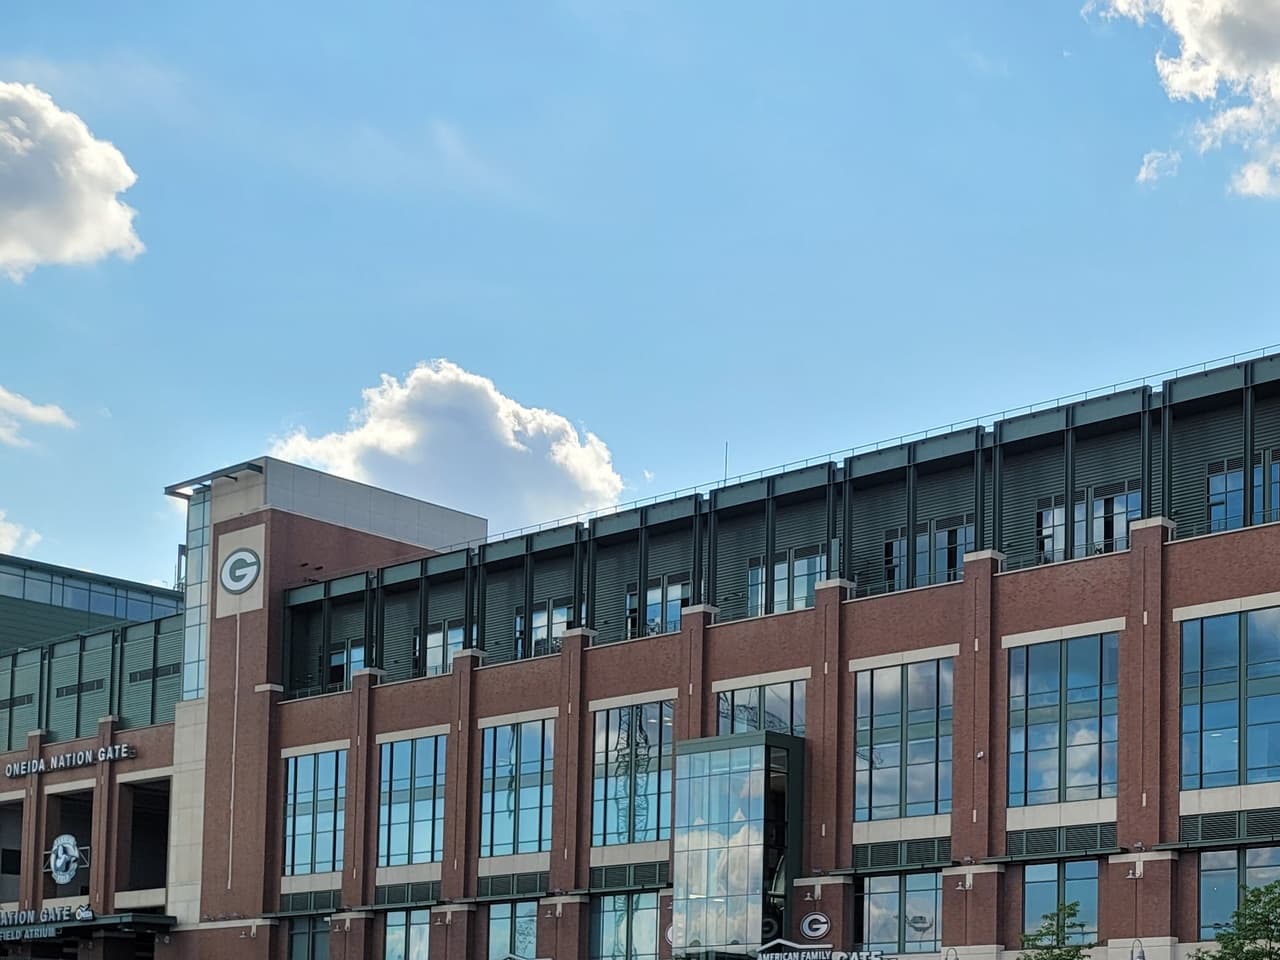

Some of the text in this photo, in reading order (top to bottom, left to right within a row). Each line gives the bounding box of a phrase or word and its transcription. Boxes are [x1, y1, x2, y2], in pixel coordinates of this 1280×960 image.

[220, 547, 261, 595] G
[5, 743, 129, 778] ONEIDA NATION GATE
[0, 910, 36, 927] ATION
[40, 905, 72, 923] GATE
[800, 911, 831, 940] G
[23, 926, 57, 940] ATRIUM
